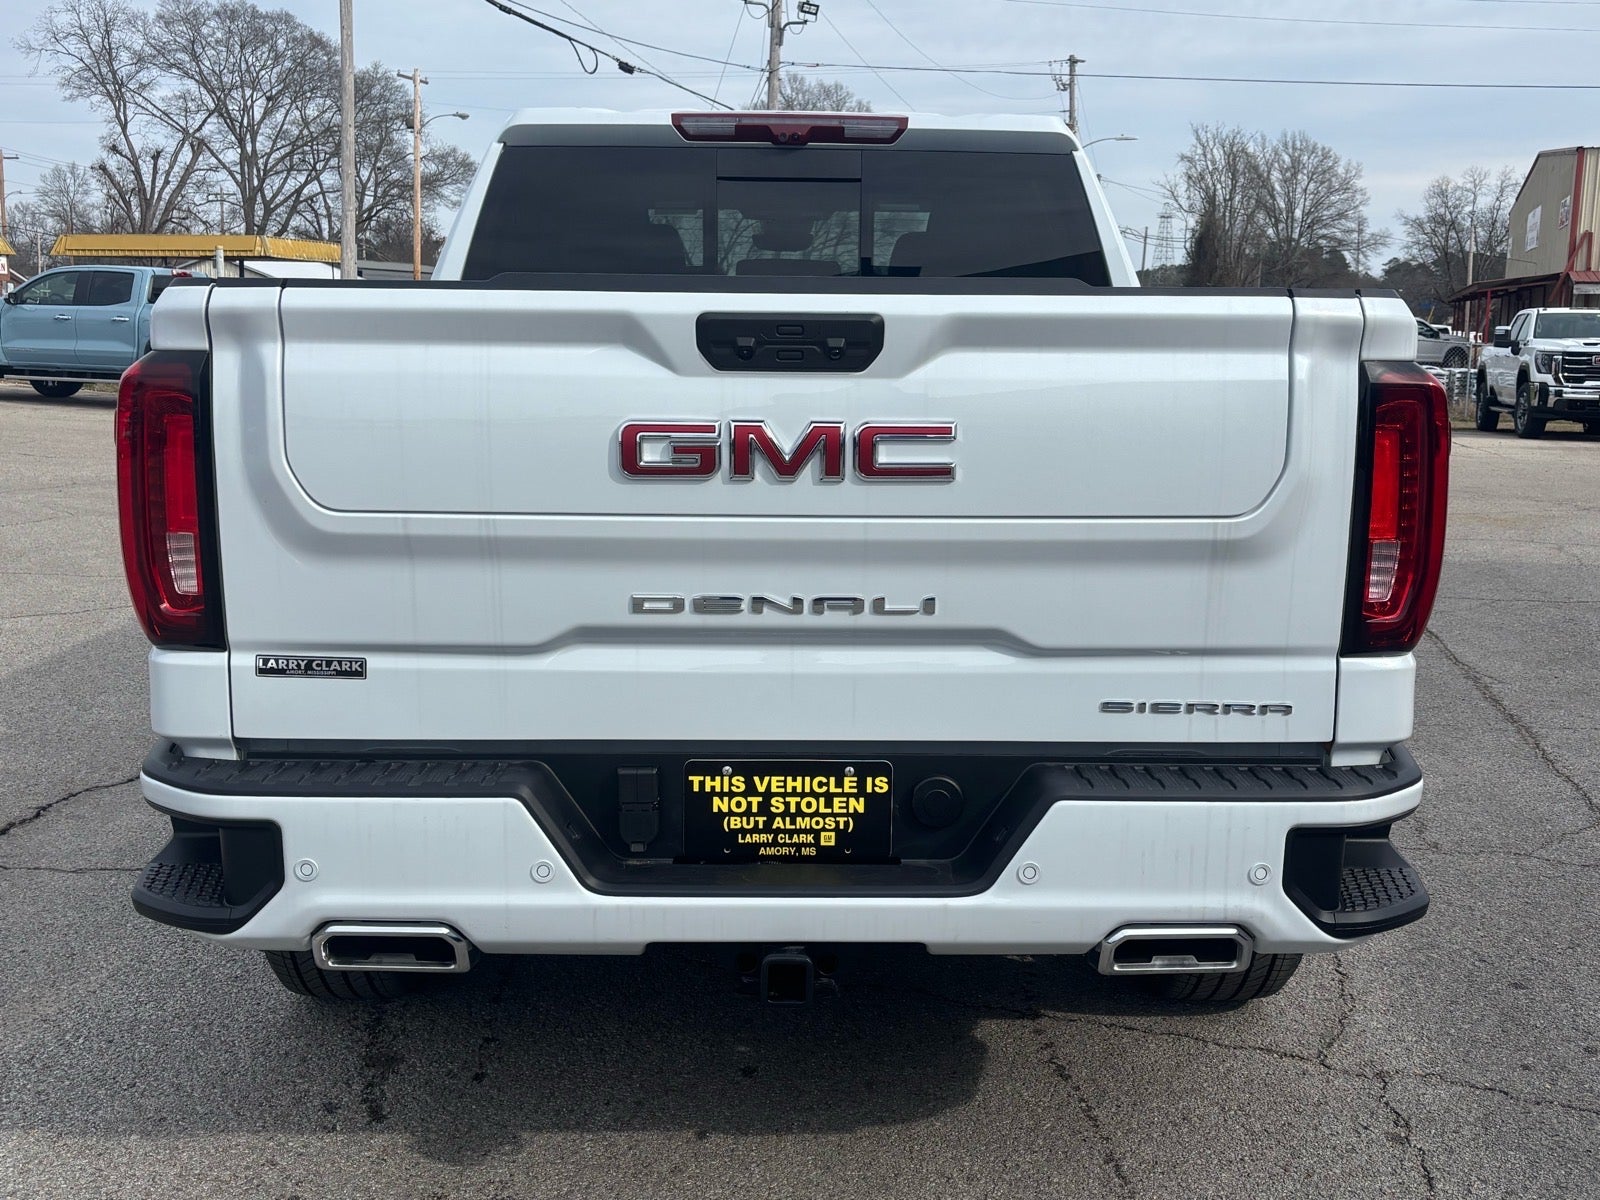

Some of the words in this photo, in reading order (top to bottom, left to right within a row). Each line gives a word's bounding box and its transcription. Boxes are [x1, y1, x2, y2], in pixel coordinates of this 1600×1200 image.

[618, 419, 957, 481] GMC
[631, 593, 936, 615] DENALI
[259, 659, 308, 669] LARRY
[312, 660, 362, 671] CLARK
[1099, 700, 1293, 716] SIERRA
[689, 776, 746, 793] THIS
[753, 776, 858, 793] VEHICLE
[866, 776, 889, 793] IS
[712, 796, 763, 813] NOT
[770, 797, 865, 813] STOLEN
[723, 816, 767, 832] (BUT
[772, 816, 854, 832] ALMOST)
[738, 833, 774, 844] LARRY
[777, 833, 815, 844] CLARK
[758, 846, 799, 857] AMORY,
[801, 846, 817, 856] MS
